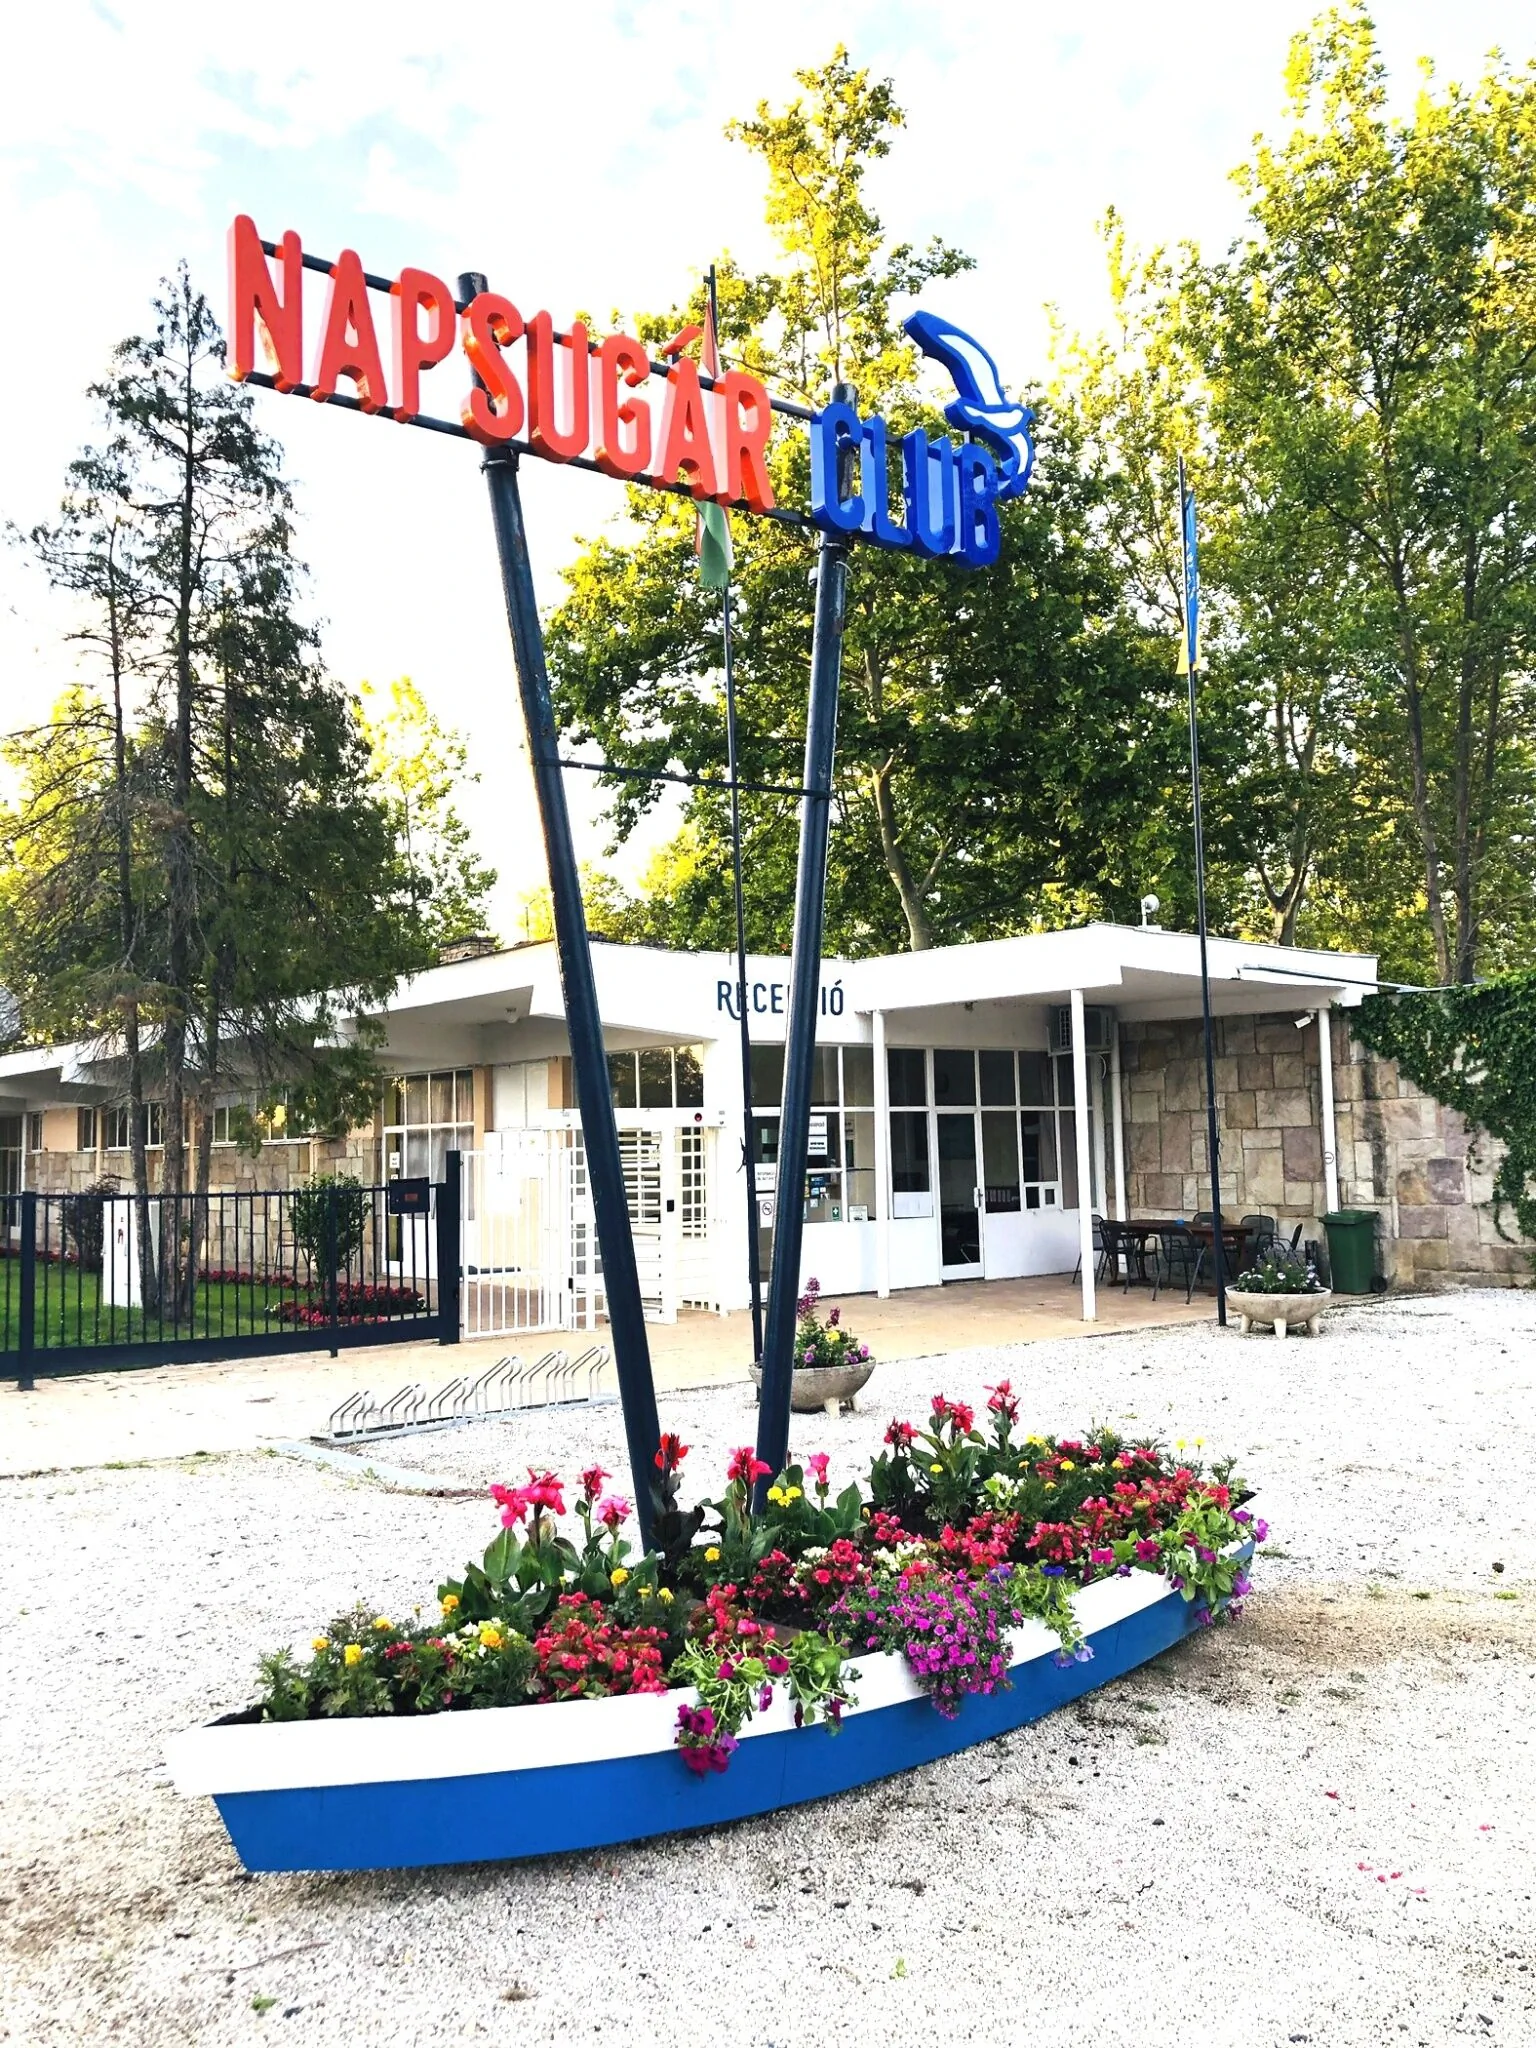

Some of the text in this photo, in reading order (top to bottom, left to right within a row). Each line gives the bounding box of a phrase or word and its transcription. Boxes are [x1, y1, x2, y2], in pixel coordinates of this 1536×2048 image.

[226, 214, 1001, 568] NAPSUGÁR CLUB
[717, 979, 844, 1020] RECEIÓ
